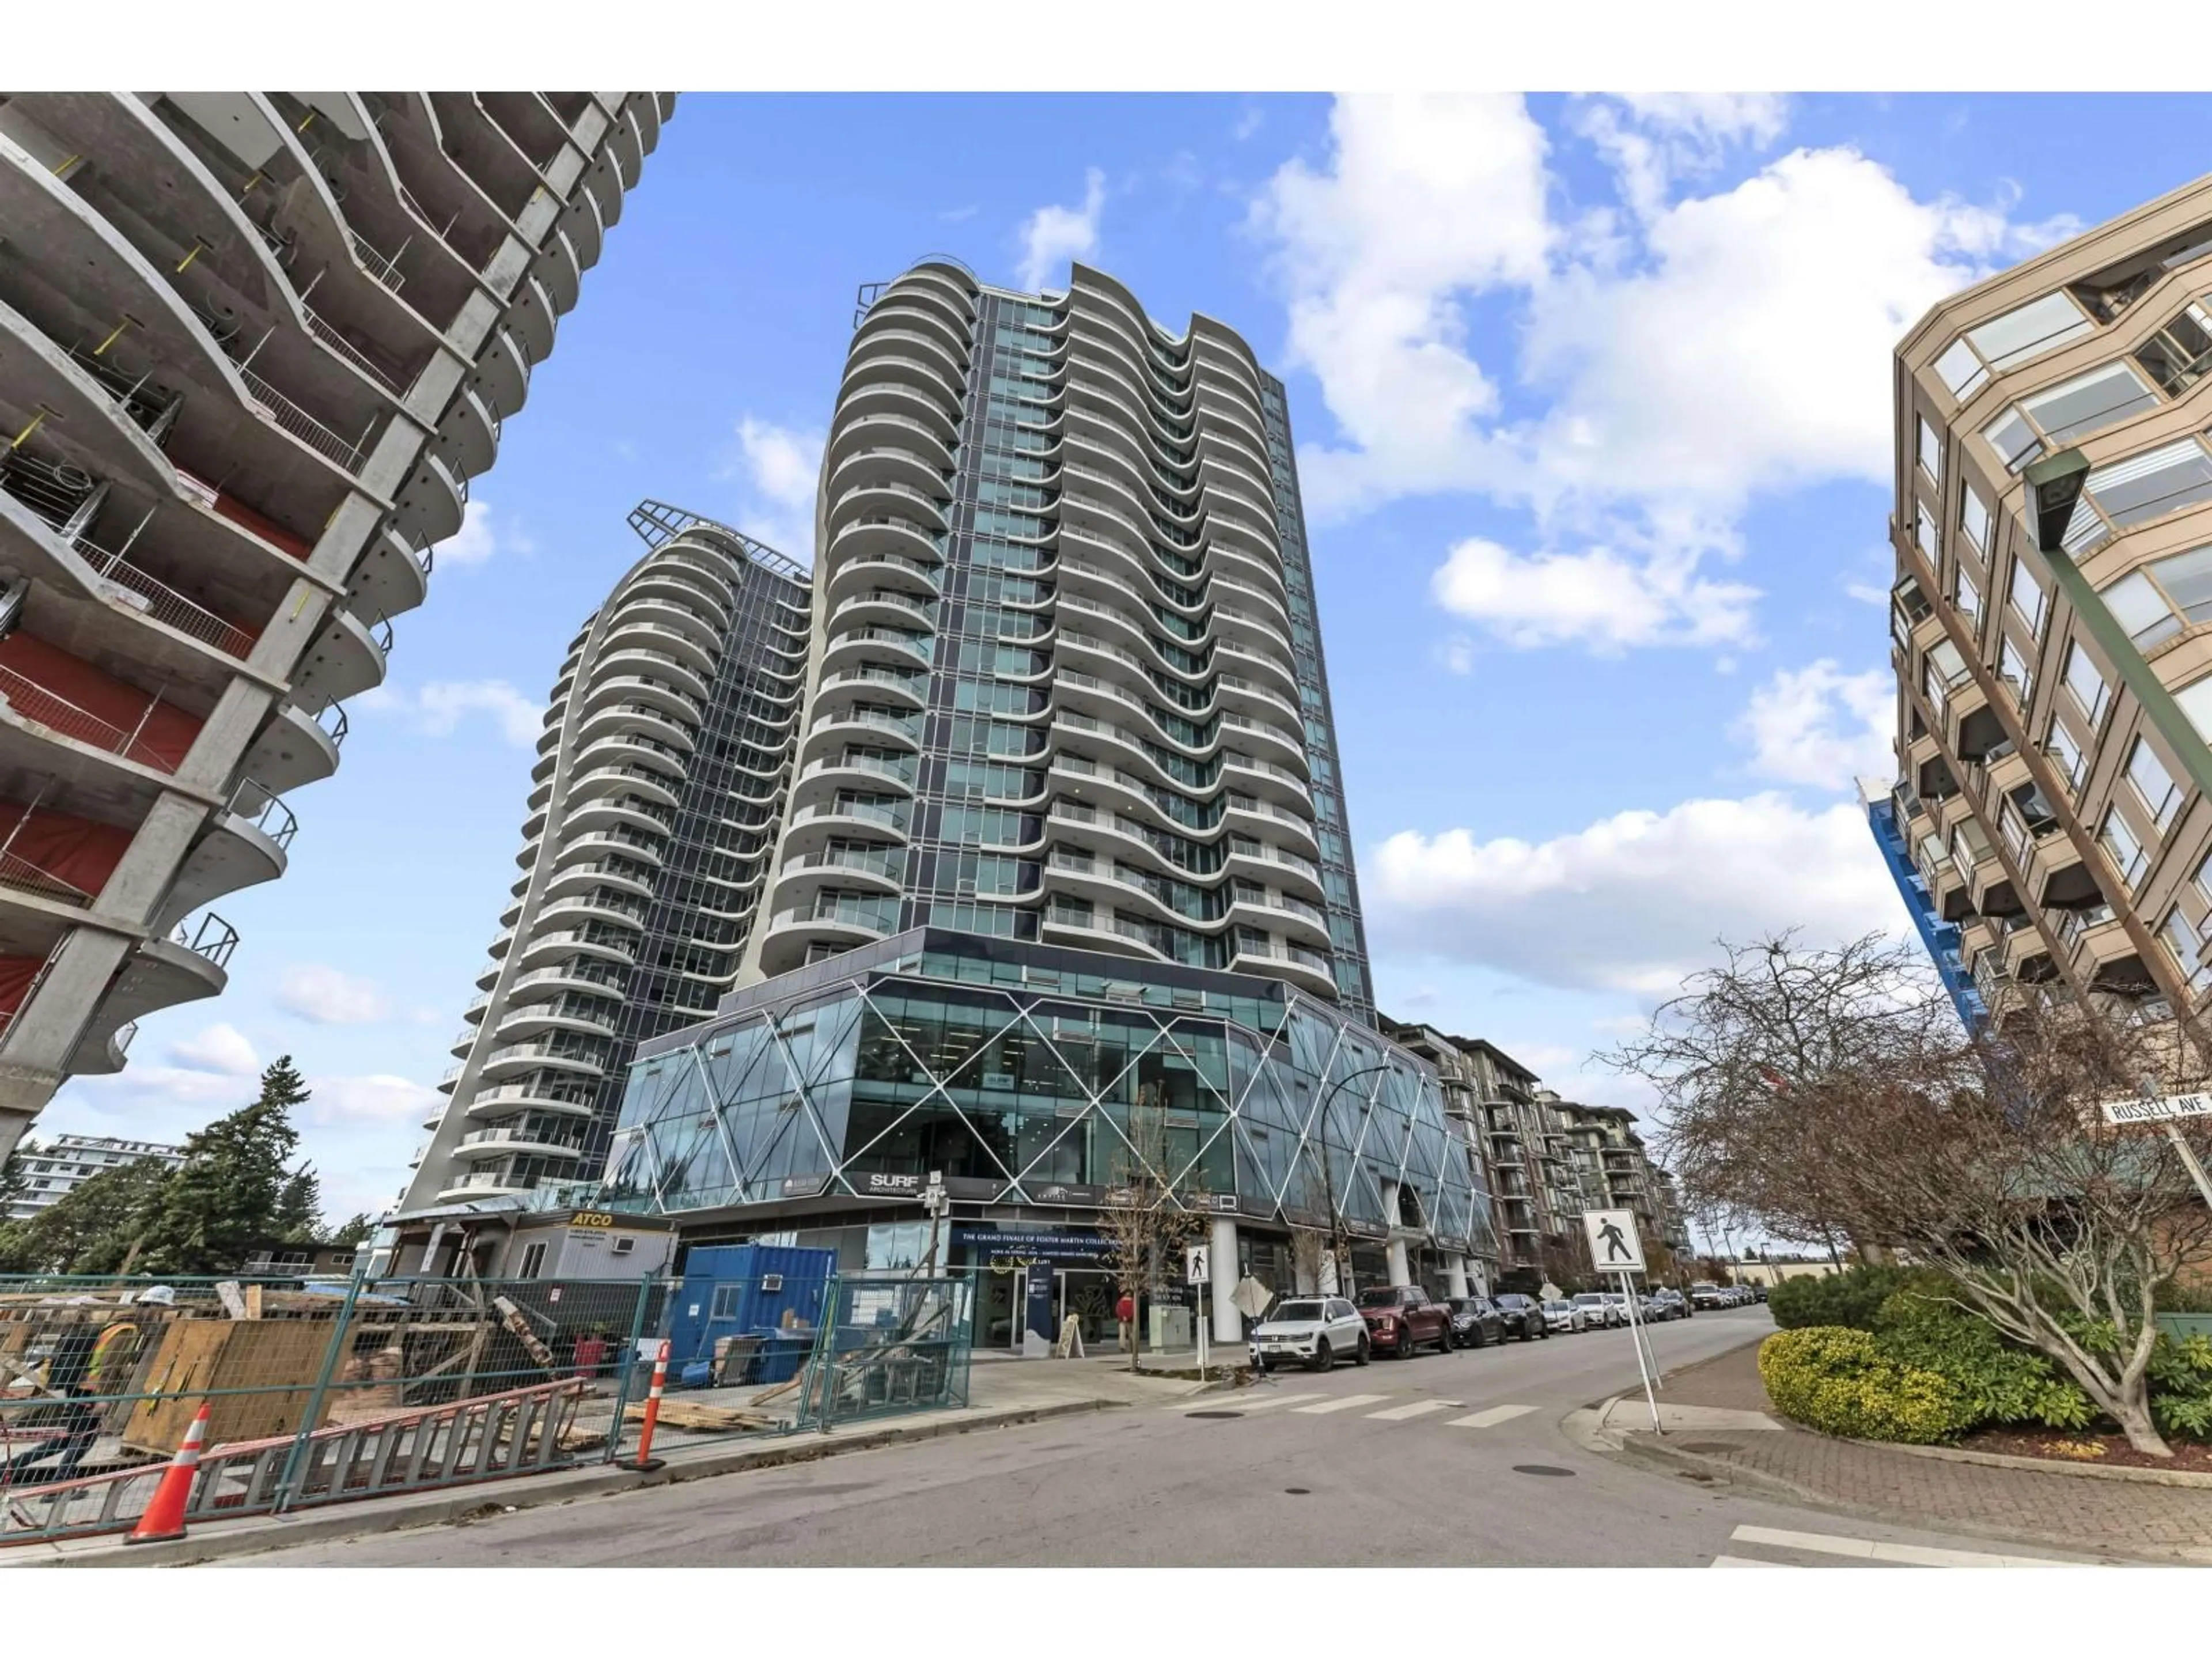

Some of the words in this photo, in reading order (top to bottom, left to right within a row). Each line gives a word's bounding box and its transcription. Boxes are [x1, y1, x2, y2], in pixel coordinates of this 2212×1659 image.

[2111, 1099, 2176, 1120] RUSSELL
[2179, 1096, 2207, 1112] AVE
[870, 1173, 919, 1187] SURF
[572, 1213, 612, 1226] ATCO
[978, 1233, 1001, 1241] GRAND
[1002, 1234, 1024, 1242] FINALE
